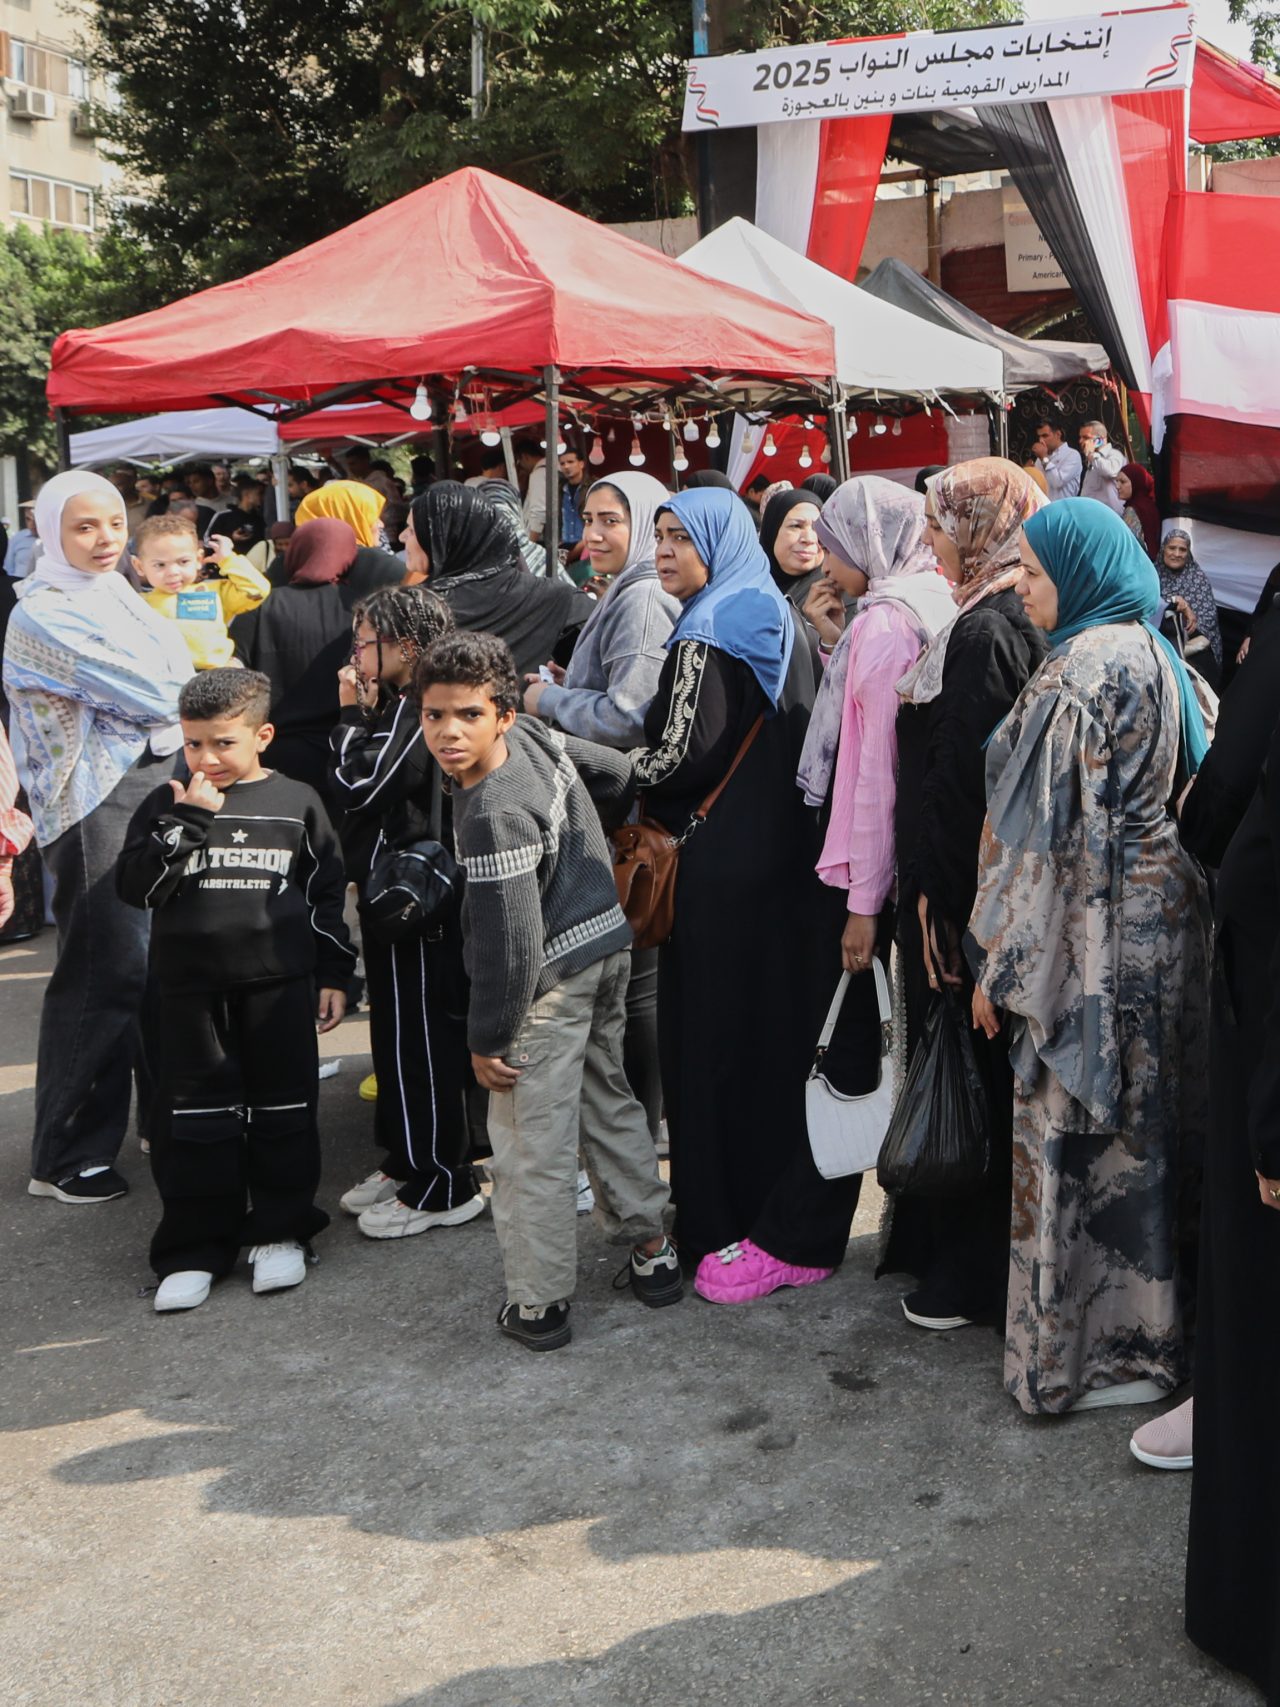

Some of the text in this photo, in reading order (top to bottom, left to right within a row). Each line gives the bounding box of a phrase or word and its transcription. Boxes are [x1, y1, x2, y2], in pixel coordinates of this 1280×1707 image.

[839, 47, 910, 80] النواب
[915, 41, 995, 73] مجلس
[753, 58, 831, 91] 2025
[782, 71, 1070, 117] المدارس القومية بنات و بنين بالعجوزة
[1018, 253, 1043, 262] Primary
